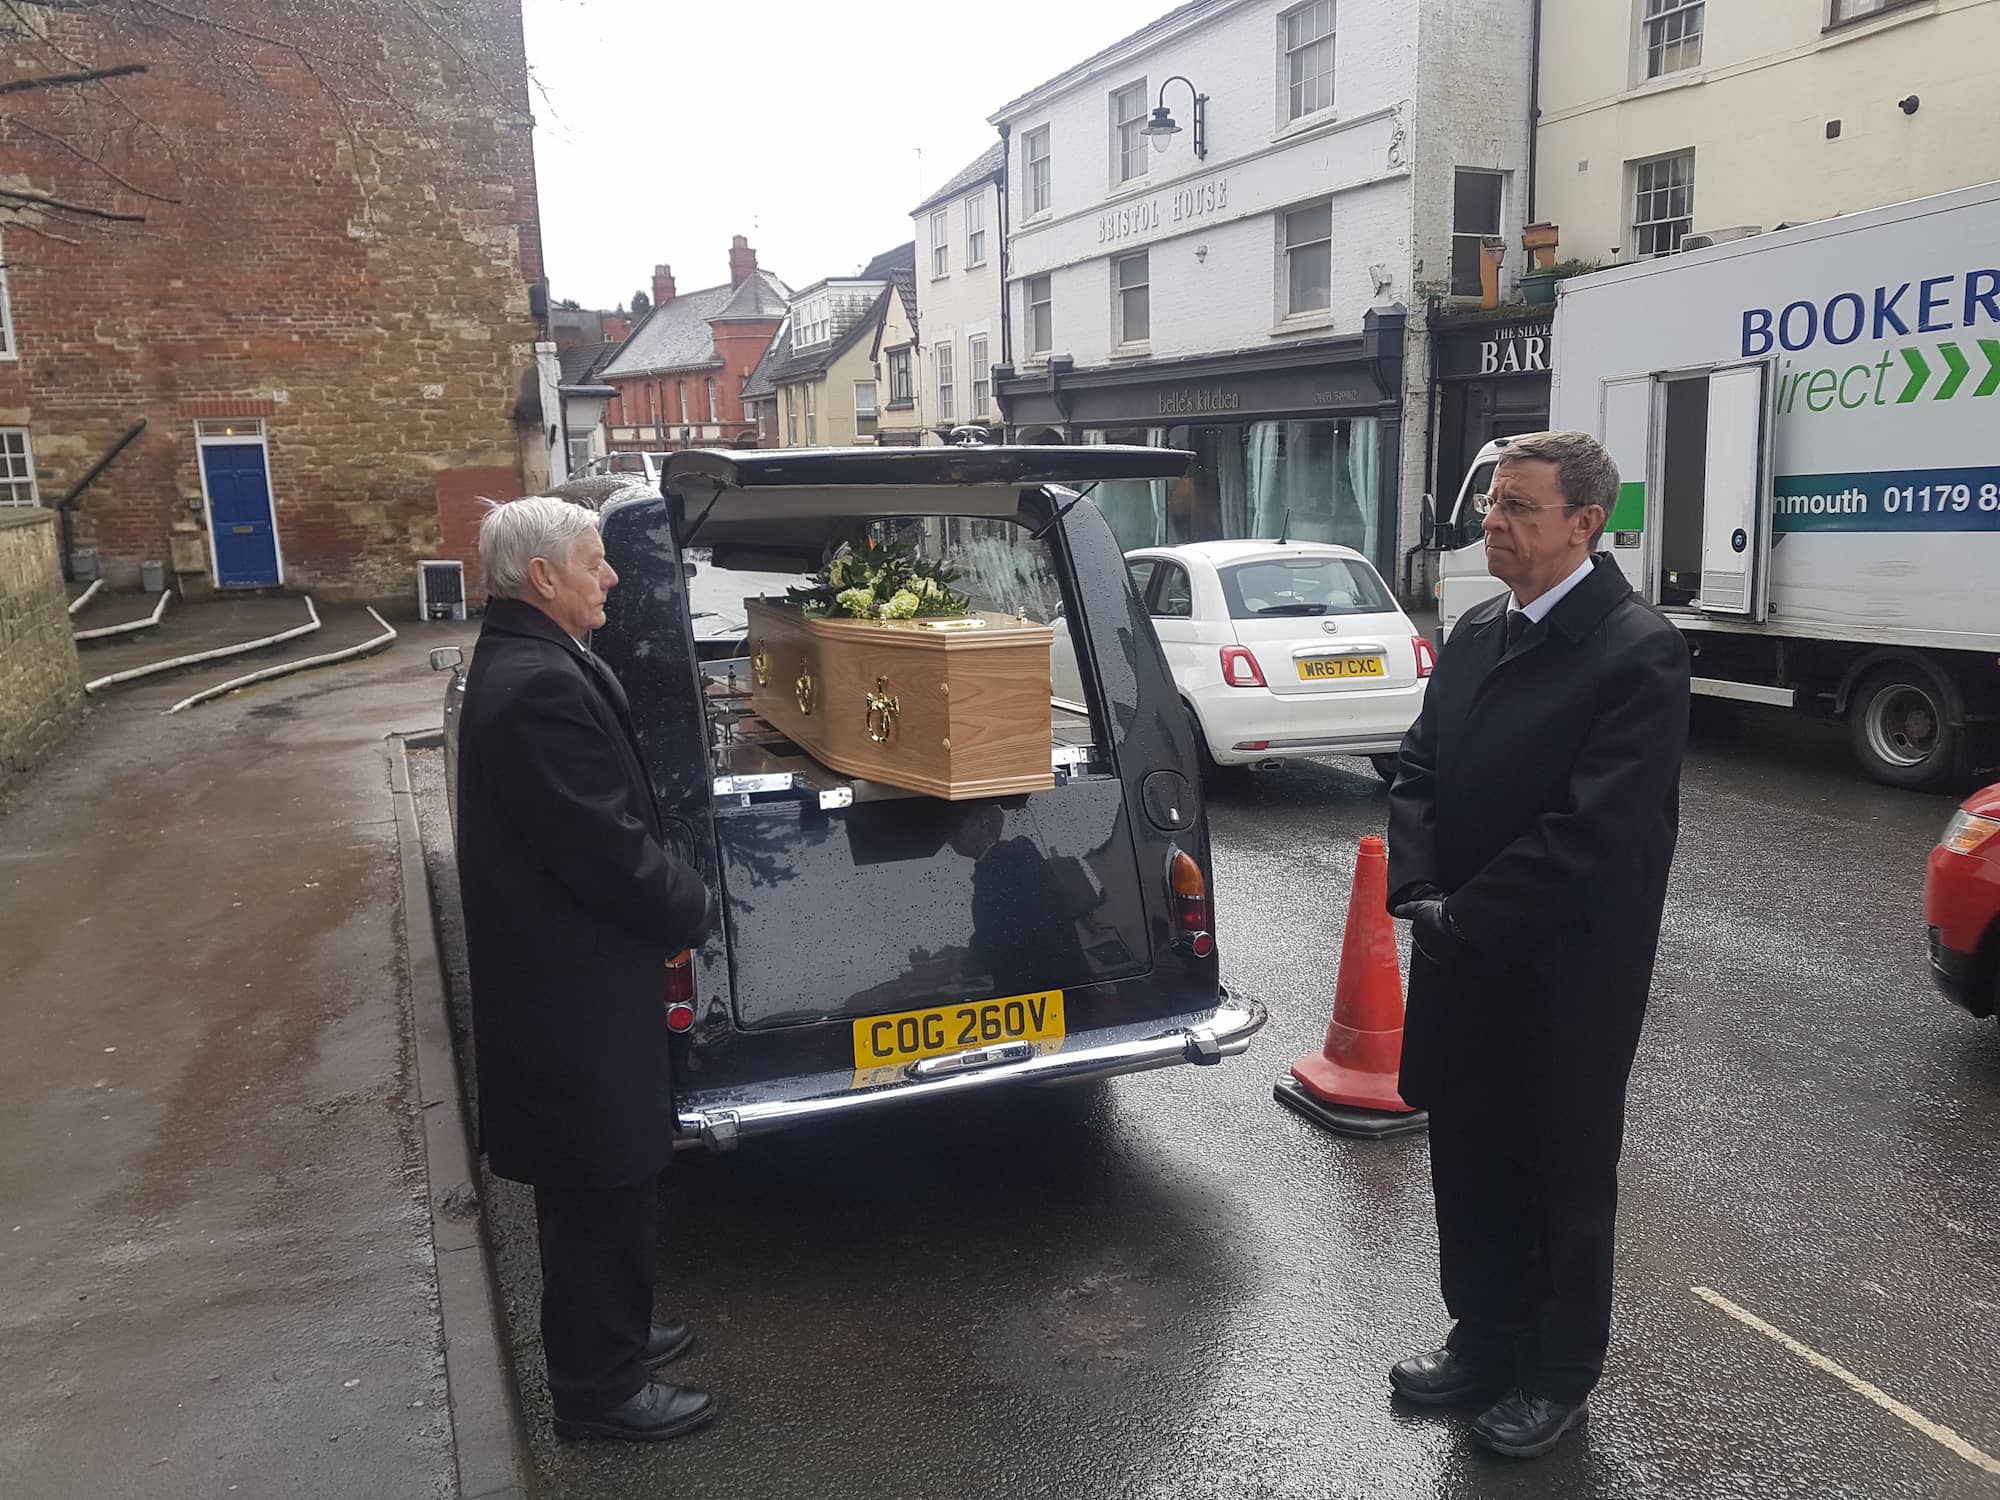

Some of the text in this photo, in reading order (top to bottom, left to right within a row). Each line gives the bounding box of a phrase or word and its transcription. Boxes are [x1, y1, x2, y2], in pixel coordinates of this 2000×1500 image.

[1098, 179, 1227, 243] BRISTOL HOUSE
[1741, 268, 2000, 358] BOOKER
[1495, 327, 1516, 340] THE
[1479, 336, 1553, 375] BAR
[1159, 387, 1240, 414] belle's kitchen
[1883, 484, 1971, 513] 01179
[1978, 483, 2000, 512] 8
[1304, 659, 1377, 677] WR67 CXC
[871, 997, 1047, 1057] COG 260V
